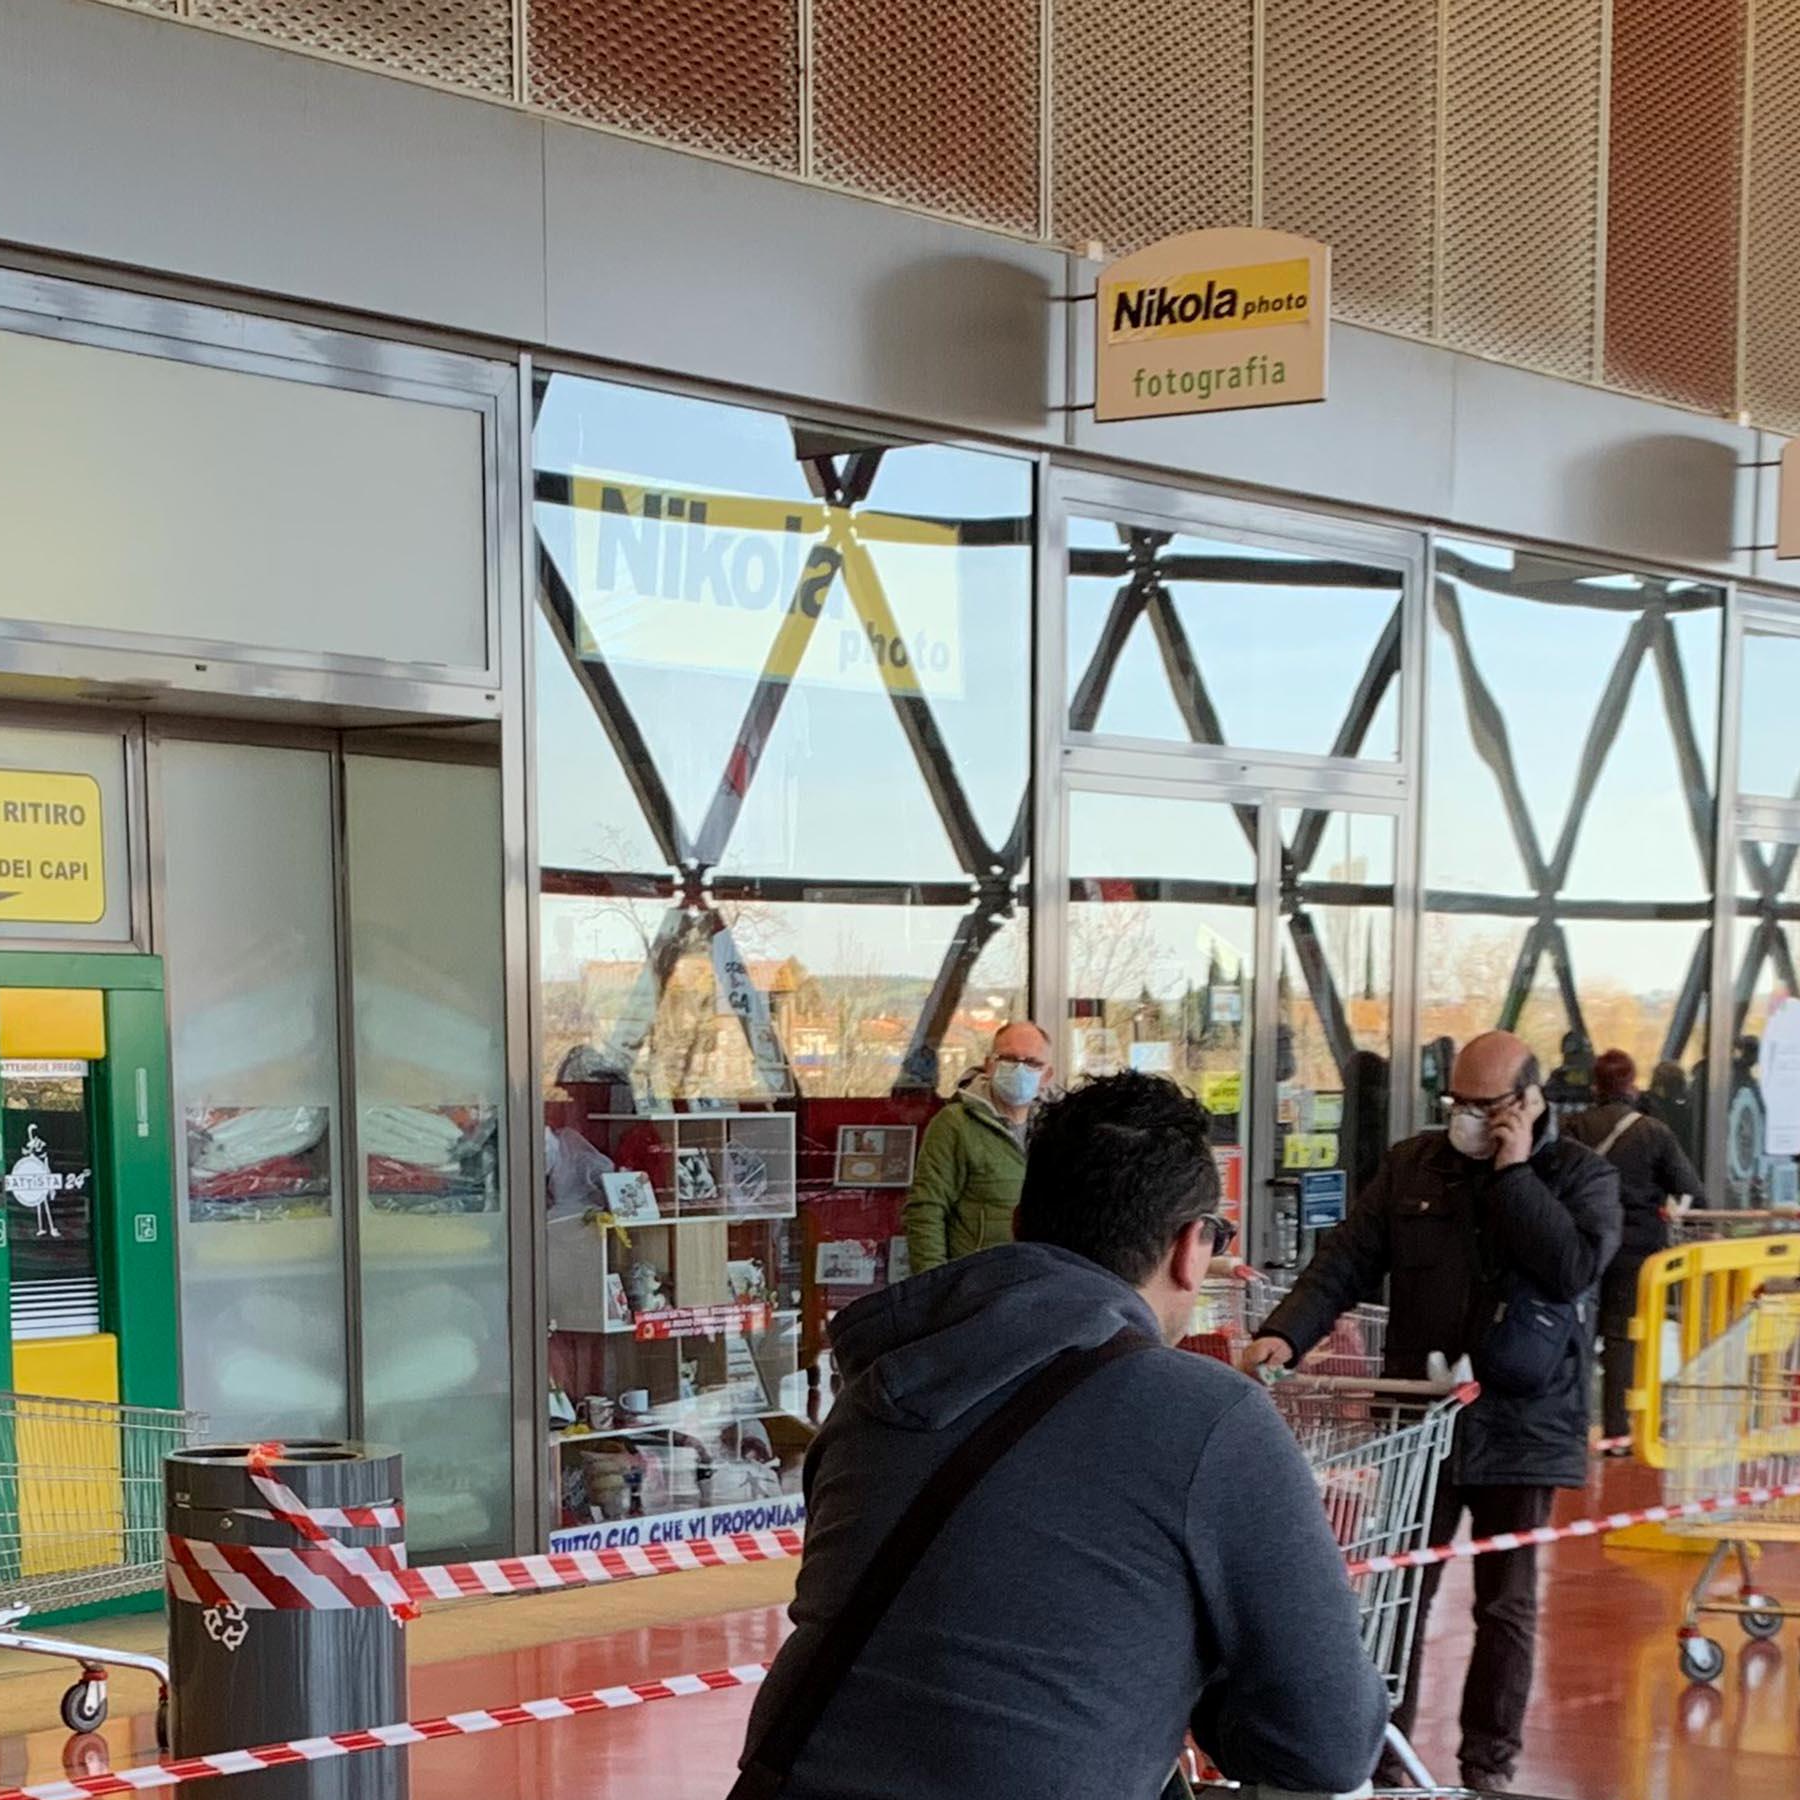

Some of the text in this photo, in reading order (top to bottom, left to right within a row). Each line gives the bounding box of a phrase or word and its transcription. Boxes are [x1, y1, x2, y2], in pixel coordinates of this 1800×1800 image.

[1113, 280, 1307, 331] Nikola photo
[1133, 355, 1286, 399] fotografia
[597, 487, 844, 621] Nikola
[839, 621, 950, 672] photo
[4, 801, 86, 826] RITIRO
[40, 861, 88, 881] CAPI
[649, 1519, 683, 1545] CHE
[689, 1516, 706, 1539] VI
